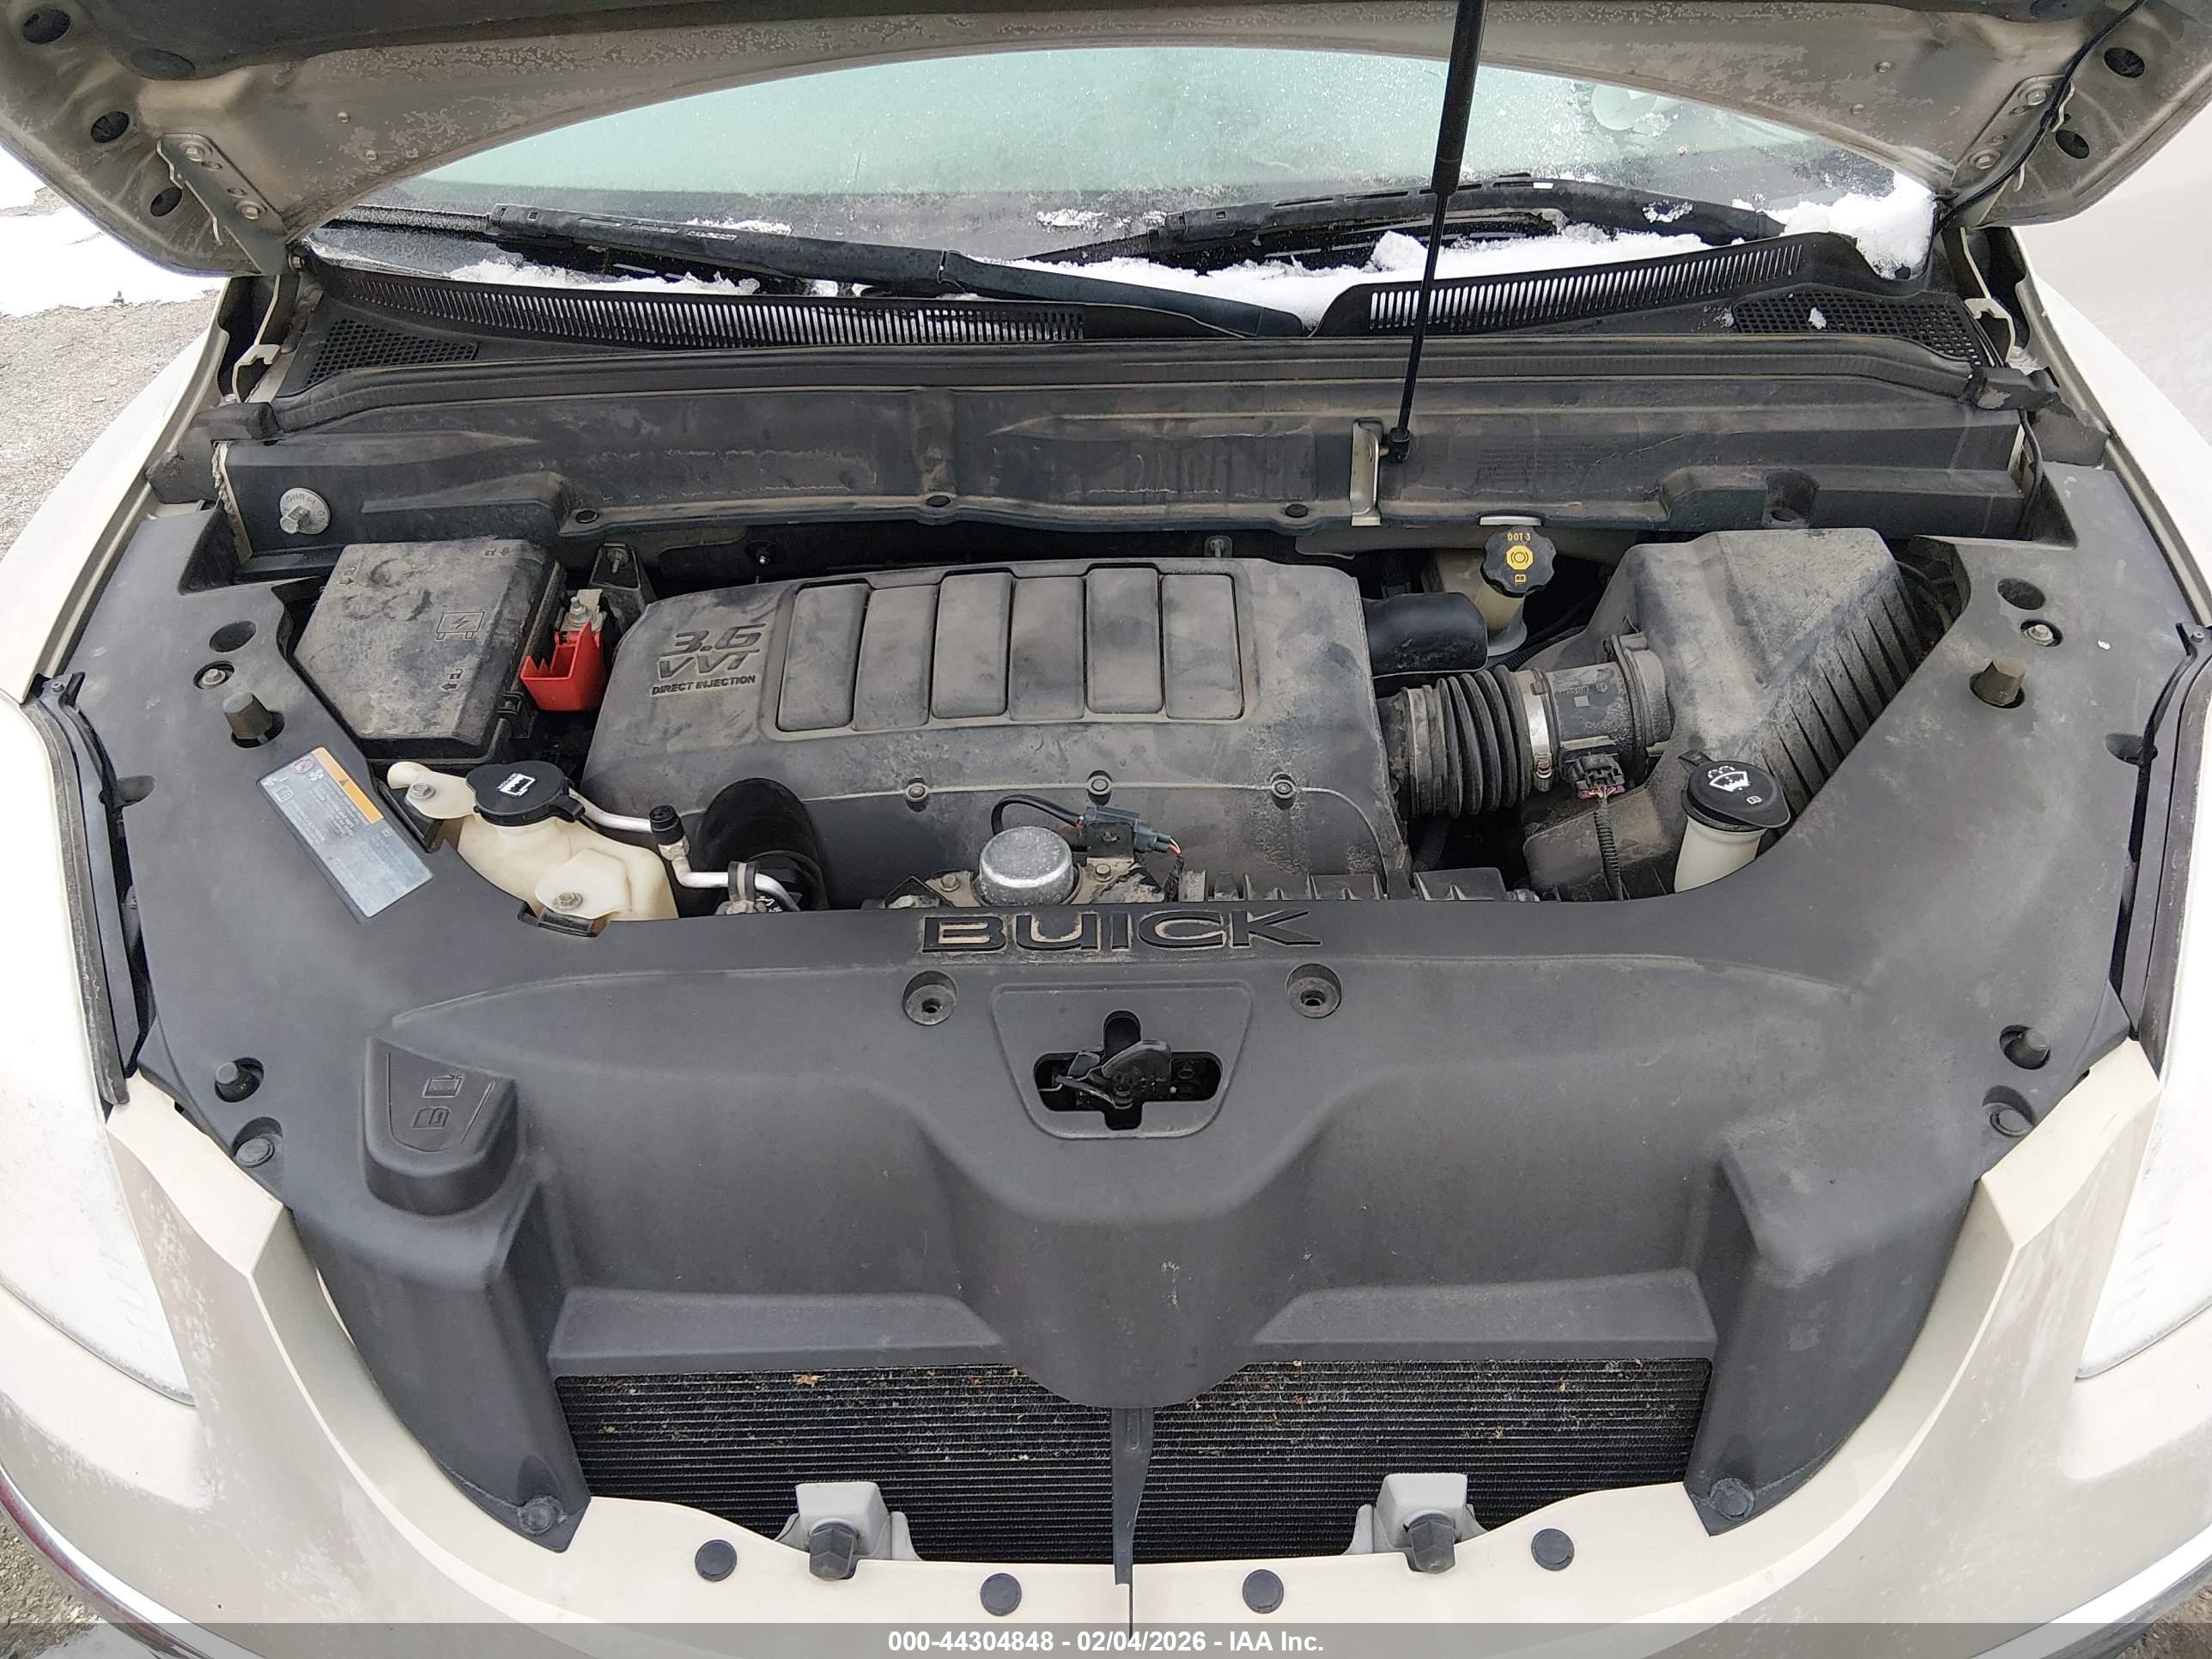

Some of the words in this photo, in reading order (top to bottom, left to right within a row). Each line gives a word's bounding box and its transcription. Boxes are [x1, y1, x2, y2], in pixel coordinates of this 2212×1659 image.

[1507, 532, 1523, 541] DOT
[1524, 532, 1531, 541] 3
[661, 623, 766, 656] 3.6
[659, 649, 761, 679] VVT
[651, 681, 694, 696] DIRECT
[696, 675, 756, 690] INJECTION
[922, 908, 1322, 953] BUICK
